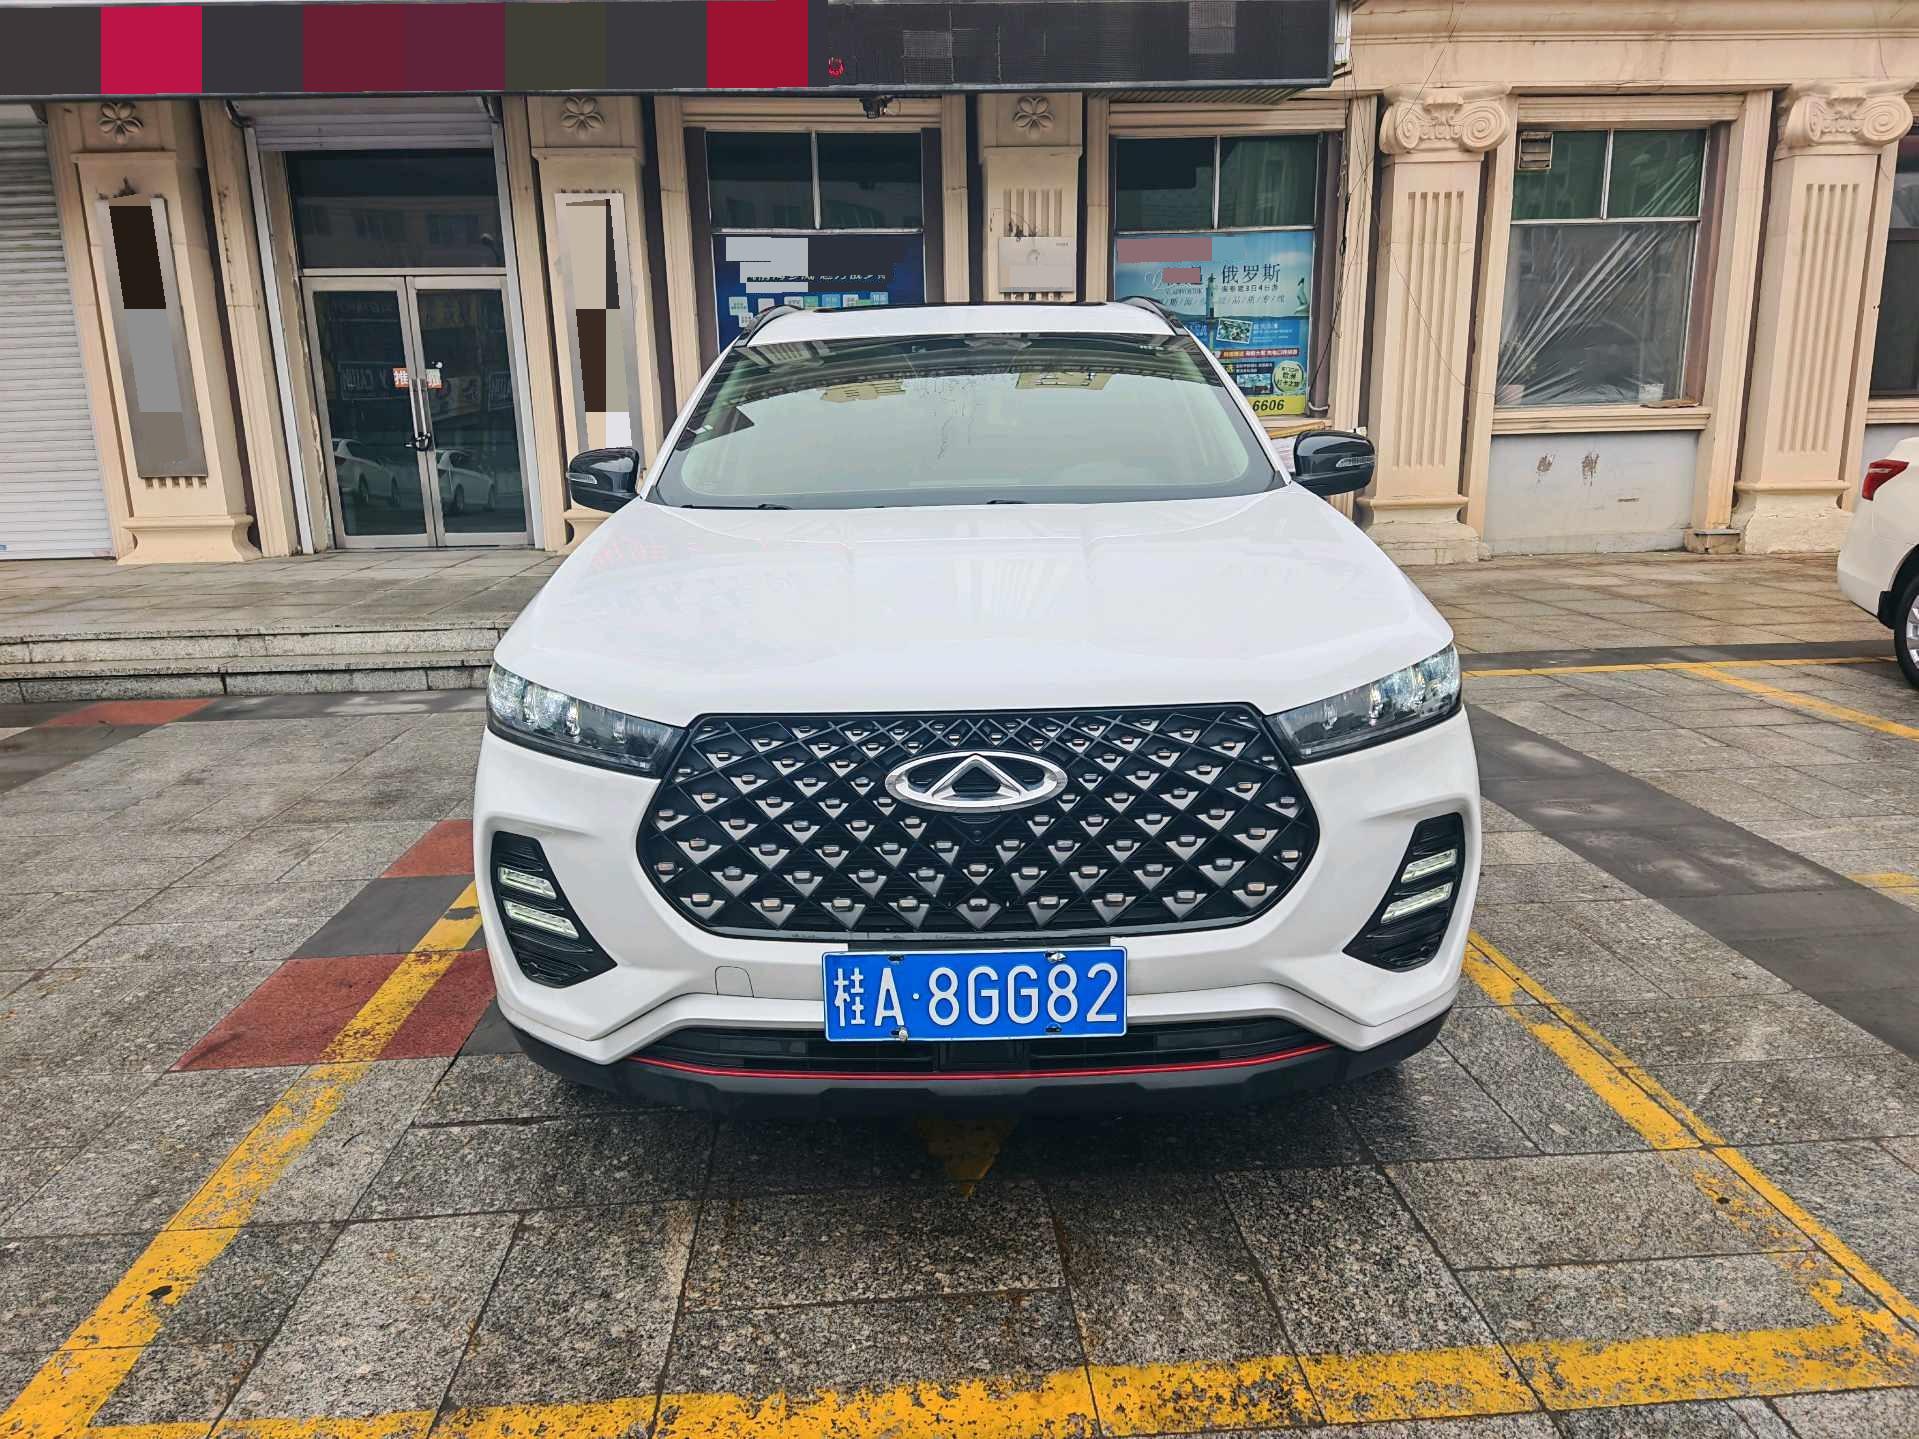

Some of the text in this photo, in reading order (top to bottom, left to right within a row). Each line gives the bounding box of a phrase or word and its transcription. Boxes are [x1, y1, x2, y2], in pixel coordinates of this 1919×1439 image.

[1222, 263, 1281, 284] 俄罗斯
[393, 370, 409, 385] 推
[1252, 399, 1285, 412] 6606
[834, 963, 1118, 1027] 桂A·8GG82
